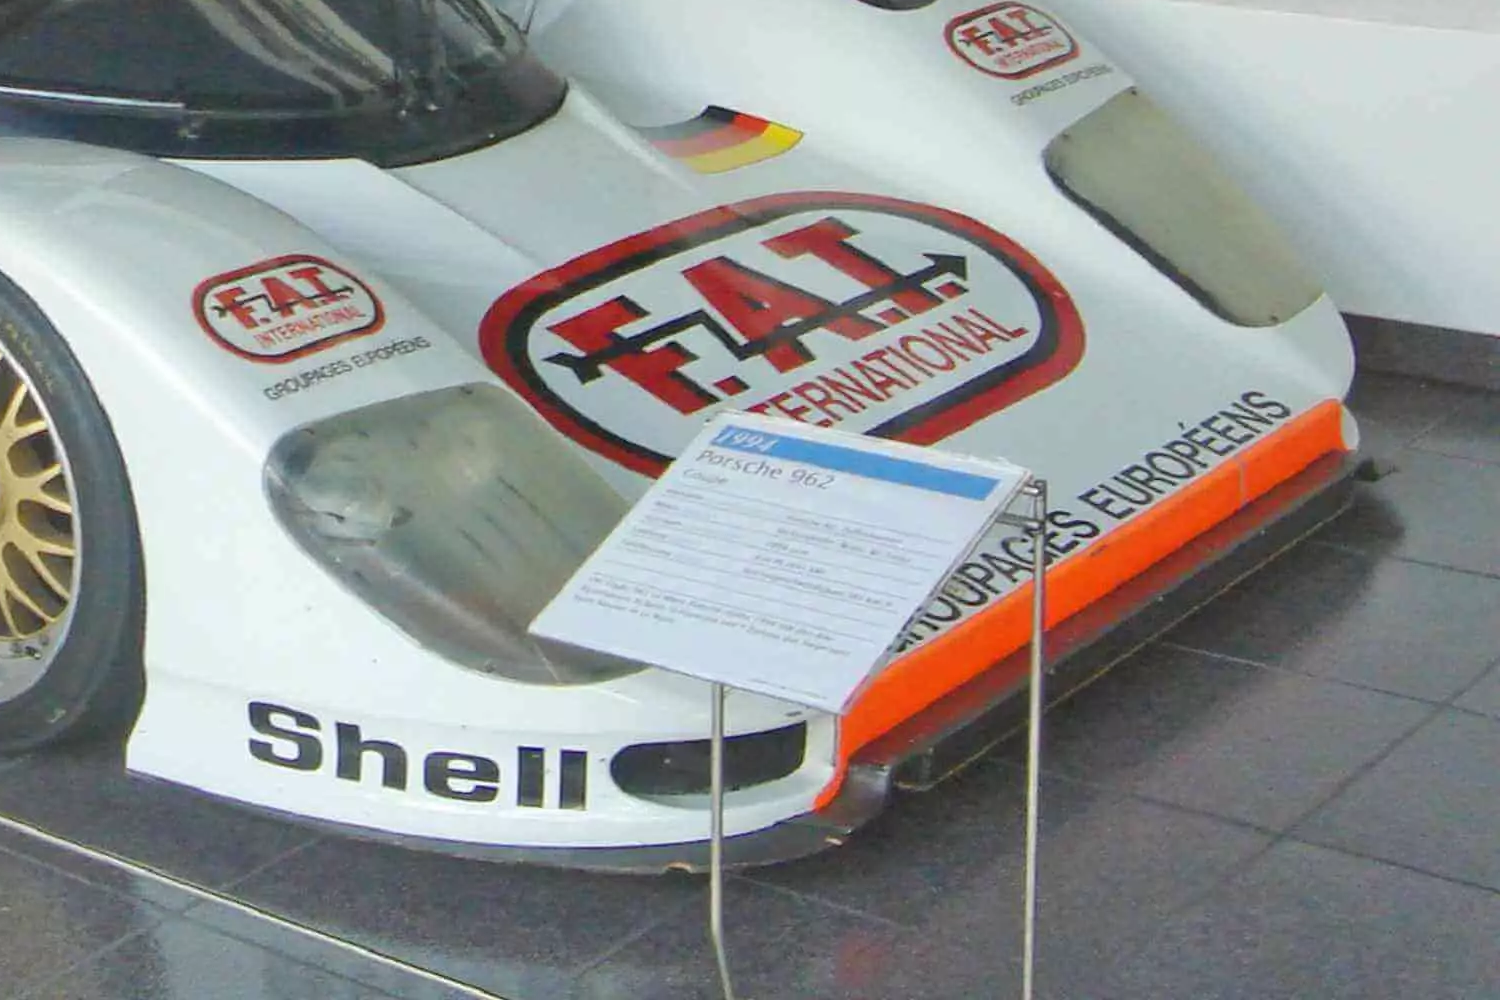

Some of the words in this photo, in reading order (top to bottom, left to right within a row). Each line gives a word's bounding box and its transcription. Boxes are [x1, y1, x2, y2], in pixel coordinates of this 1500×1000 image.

[253, 304, 367, 349] INTERNATIONAL
[262, 358, 354, 402] GROUPAGES
[743, 307, 1027, 428] ERNATIONAL
[715, 426, 779, 452] 1994
[1077, 391, 1291, 520] EUROPÉENS
[695, 449, 784, 480] Porsche
[788, 466, 836, 491] 962
[248, 700, 588, 811] Shell
